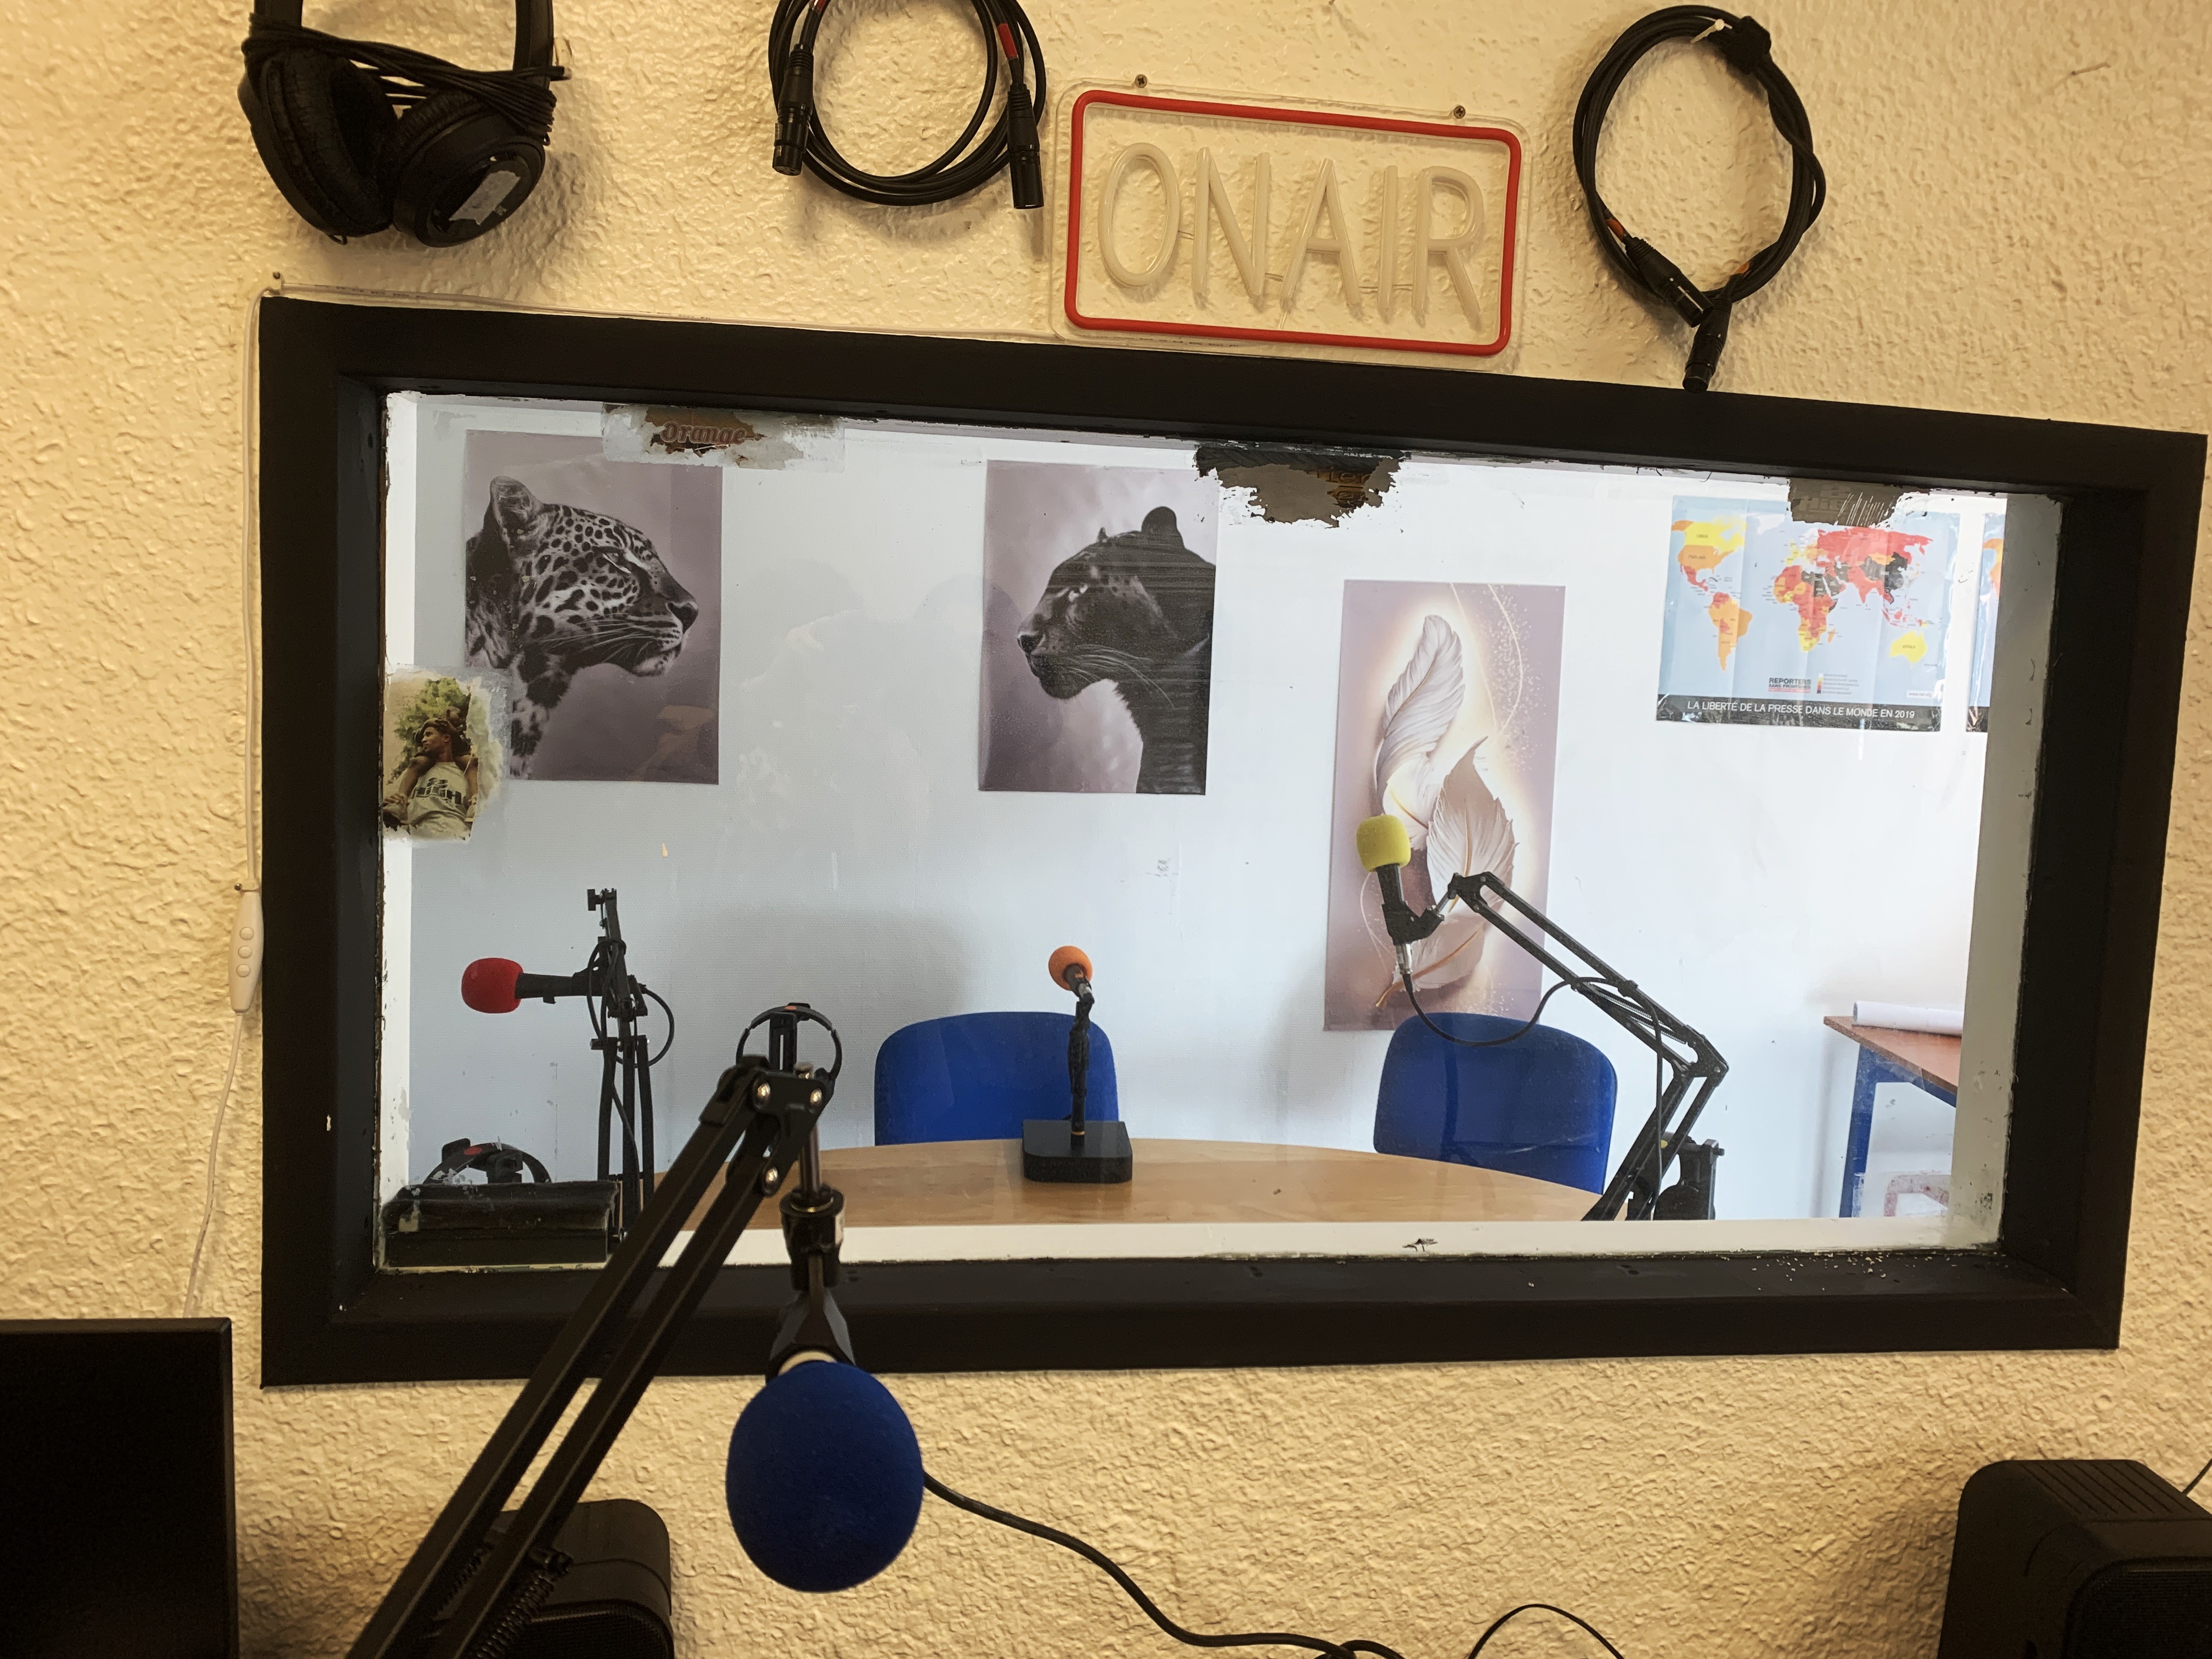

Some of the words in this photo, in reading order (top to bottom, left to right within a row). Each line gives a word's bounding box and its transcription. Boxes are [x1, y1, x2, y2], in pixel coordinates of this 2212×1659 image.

[660, 421, 747, 449] Orange
[1688, 701, 1700, 710] LA
[1702, 701, 1738, 712] LIBERTÉ
[1740, 703, 1752, 712] DE
[1755, 703, 1767, 713] LA
[1768, 704, 1803, 714] PRESSE
[1805, 707, 1831, 715] DANS
[1833, 707, 1844, 716] LE
[1846, 708, 1878, 718] MONDE
[1880, 709, 1893, 718] EN
[1894, 710, 1915, 719] 2019
